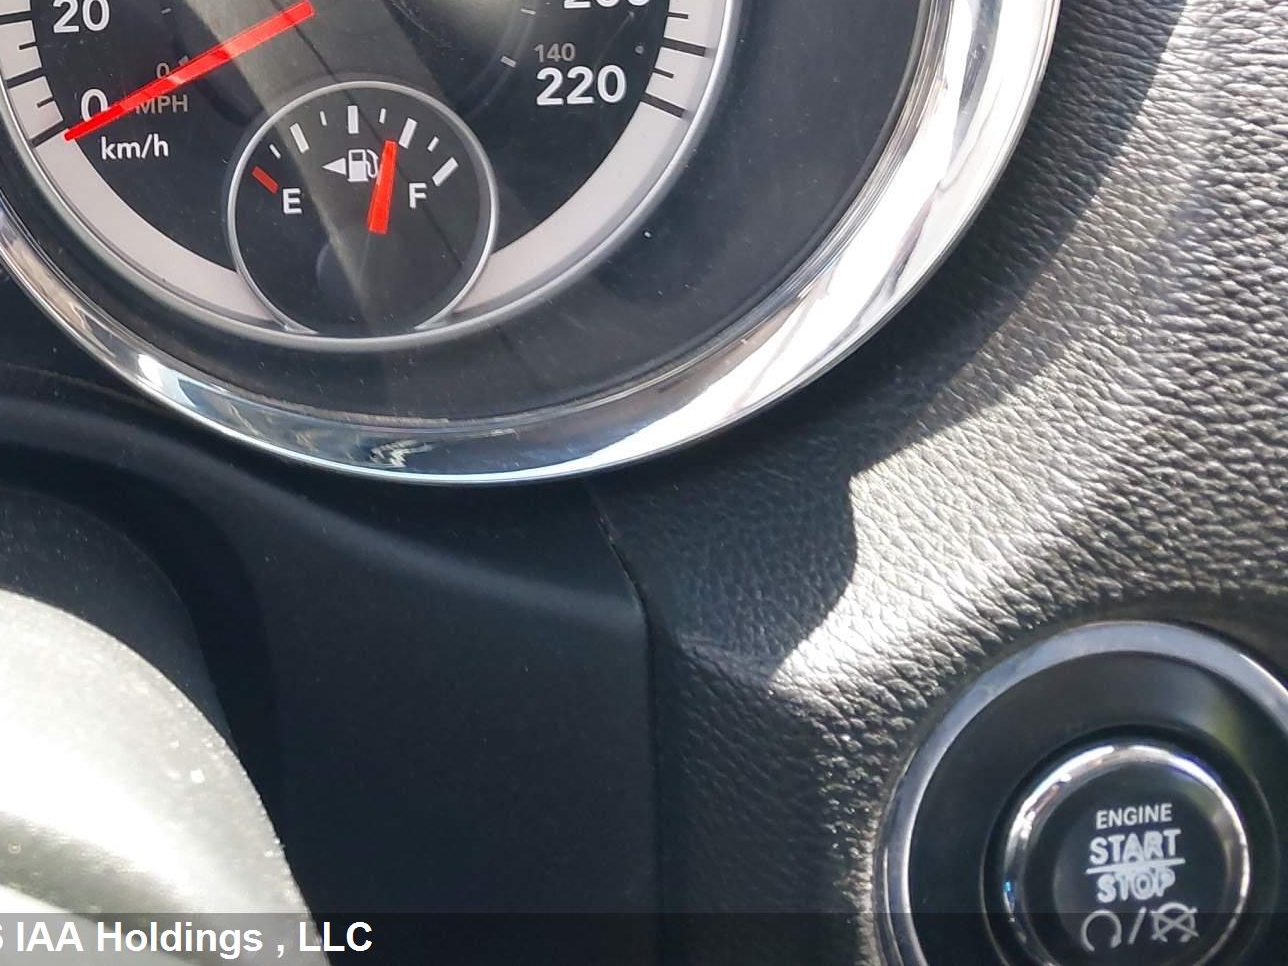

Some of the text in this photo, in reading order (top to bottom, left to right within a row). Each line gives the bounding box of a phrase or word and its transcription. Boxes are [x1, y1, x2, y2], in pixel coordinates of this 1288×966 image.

[534, 44, 576, 63] 140
[535, 65, 627, 106] 220
[80, 88, 109, 123] 0
[101, 133, 169, 160] km/h
[282, 188, 303, 213] E
[408, 183, 428, 208] F
[1096, 803, 1173, 830] ENGINE
[1089, 829, 1181, 865] START
[1097, 867, 1176, 904] STOP
